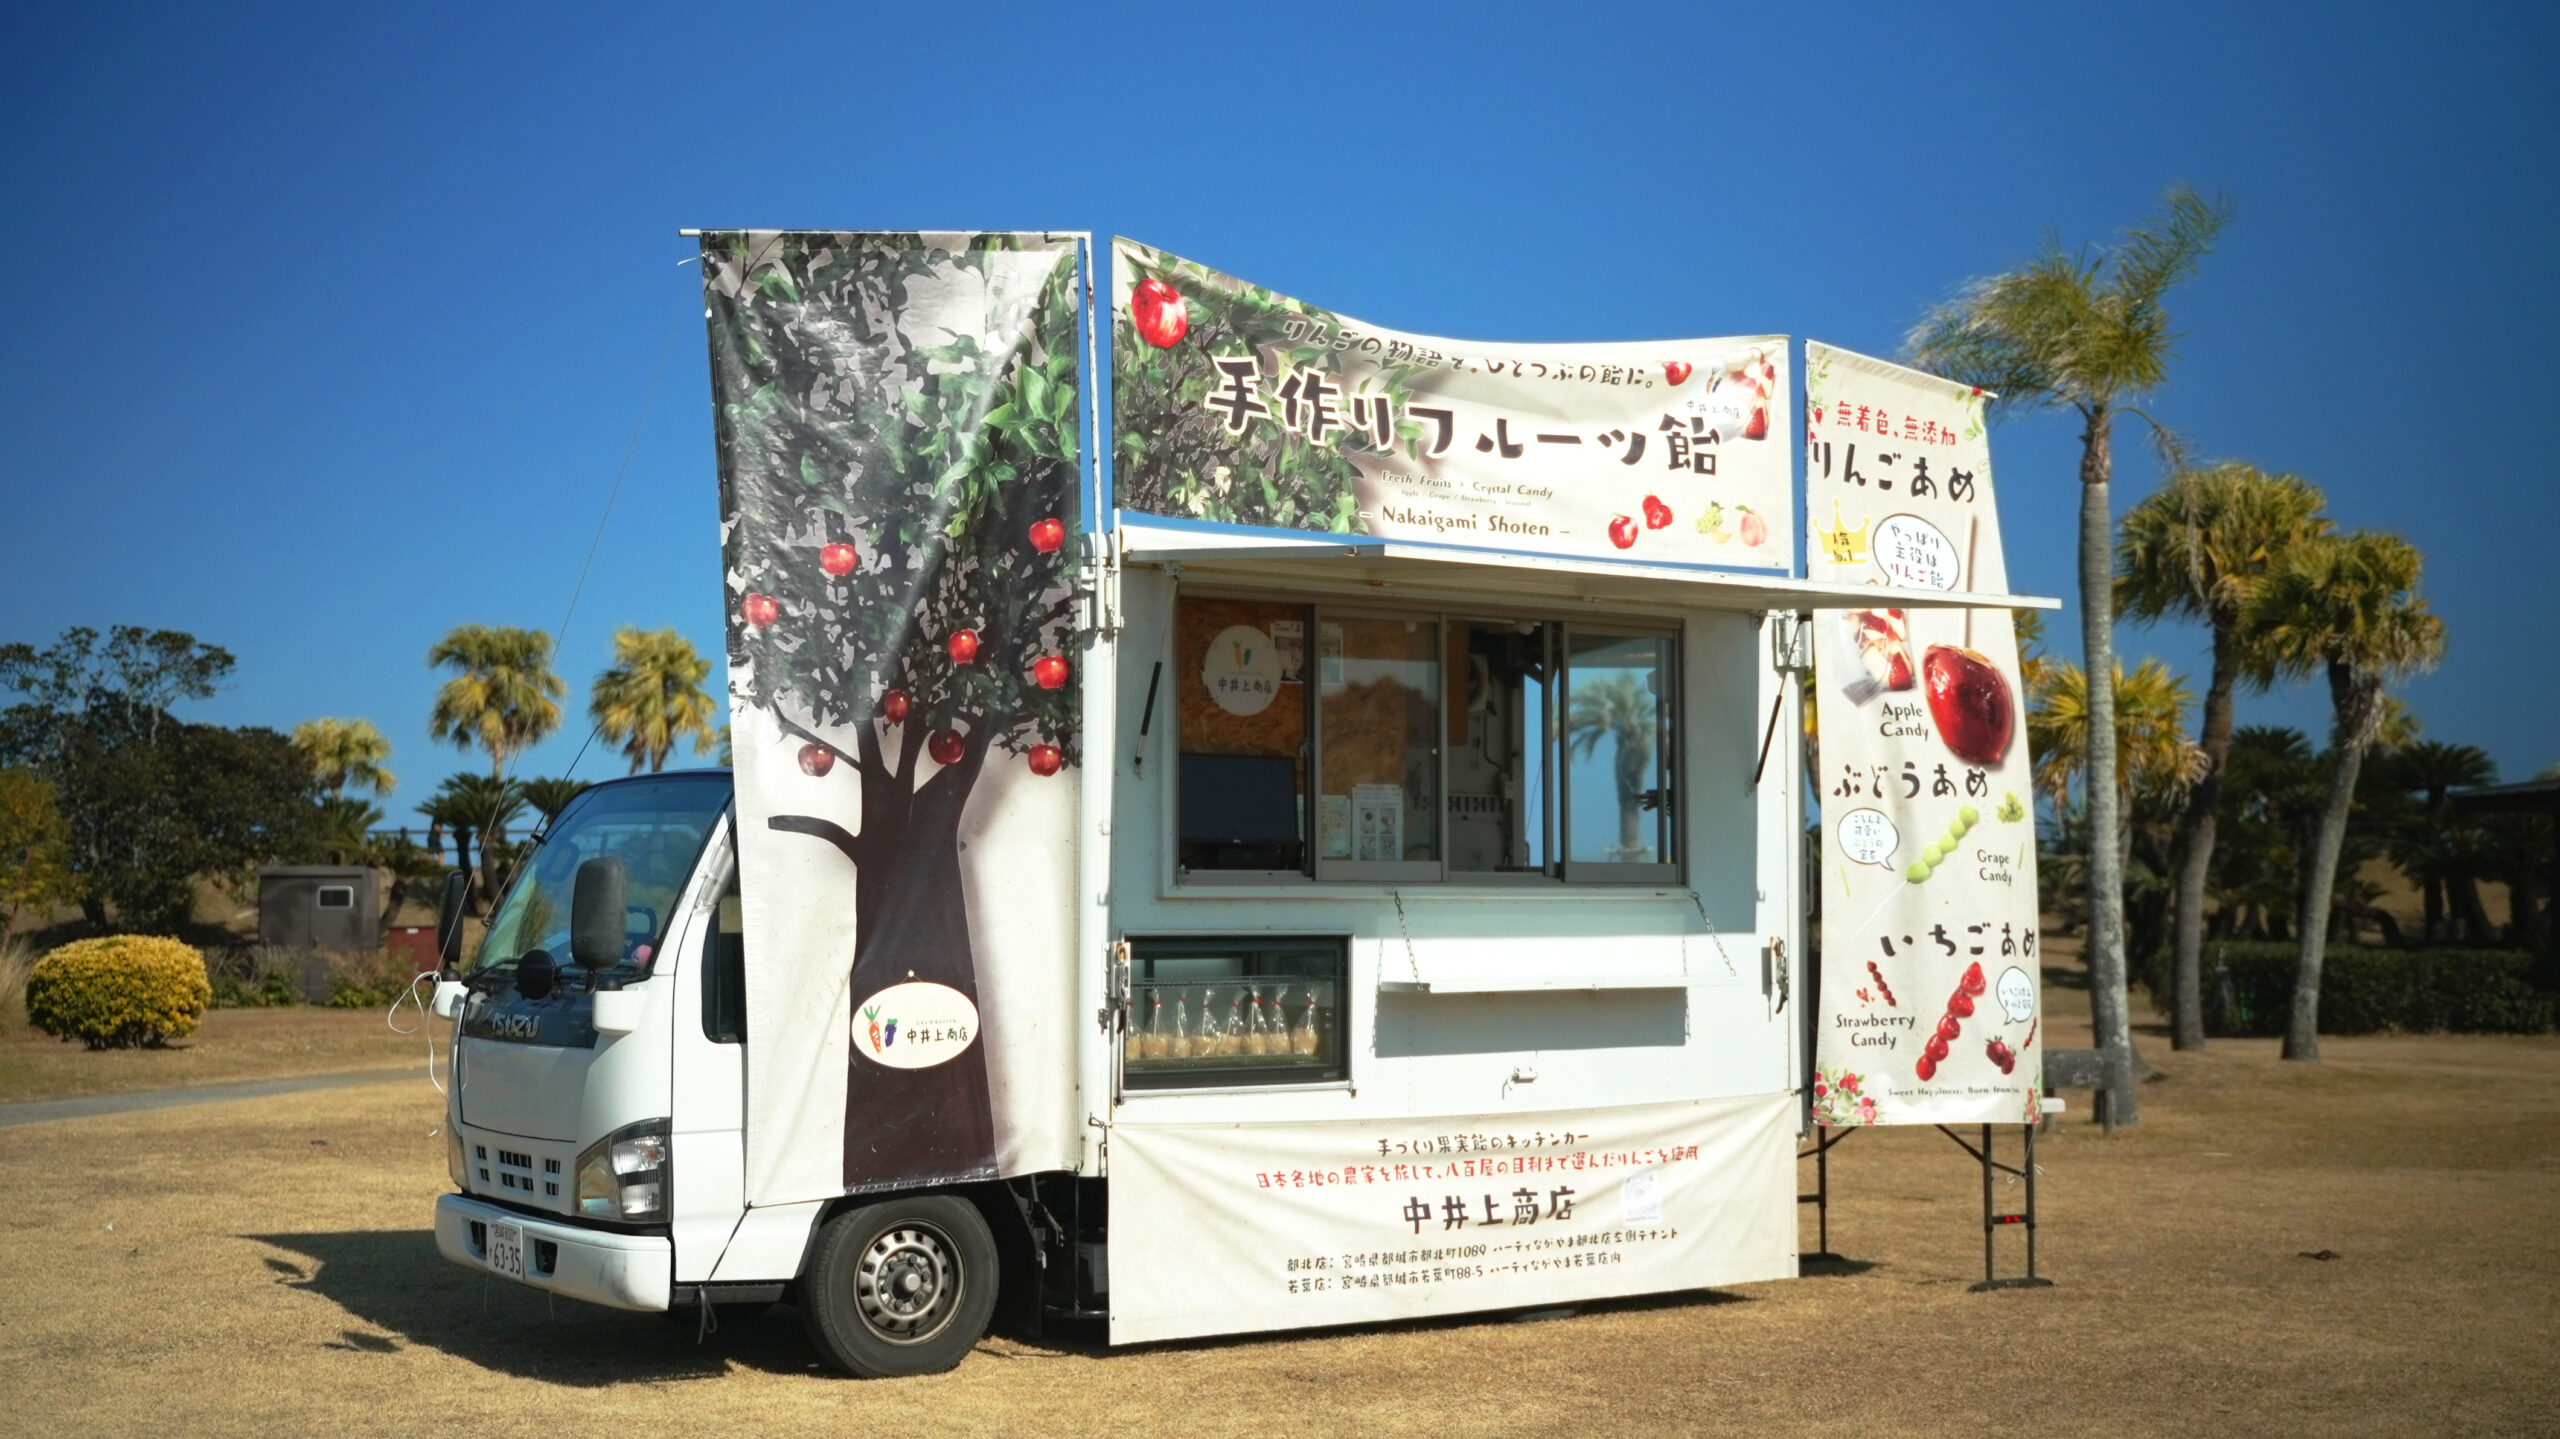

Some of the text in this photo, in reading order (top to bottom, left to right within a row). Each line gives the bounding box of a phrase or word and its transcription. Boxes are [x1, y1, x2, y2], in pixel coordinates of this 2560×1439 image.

[1206, 357, 1720, 476] 手作りフルーツ飴
[1837, 401, 1956, 446] 無着色、無添加
[1813, 441, 1975, 503] りんごあめ
[1382, 471, 1412, 484] Fresh
[1419, 475, 1452, 488] Fruits
[1472, 481, 1511, 496] Crystal
[1517, 484, 1553, 500] Candy
[1382, 505, 1549, 536] Nakaigami Shoten
[1891, 523, 1939, 550] やっぱり
[1890, 563, 1944, 588] りんご飴
[1217, 676, 1273, 695] 中井上商店
[1881, 702, 1923, 722] Apple
[1879, 721, 1929, 741] Candy
[1833, 761, 1988, 799] ぶどうあめ
[1977, 848, 2010, 867] Grape
[1979, 867, 2012, 885] Candy
[1880, 922, 2036, 958] いちごあめ
[492, 1012, 541, 1038] ISUZU
[1835, 1013, 1916, 1030] Strawberry
[907, 1026, 968, 1044] 中井上商店
[1851, 1032, 1897, 1050] Candy
[1378, 1132, 1589, 1157] 手づくり果実飴のキッチンカー
[1403, 1185, 1577, 1235] 中井上商店
[494, 1242, 521, 1275] 63-35
